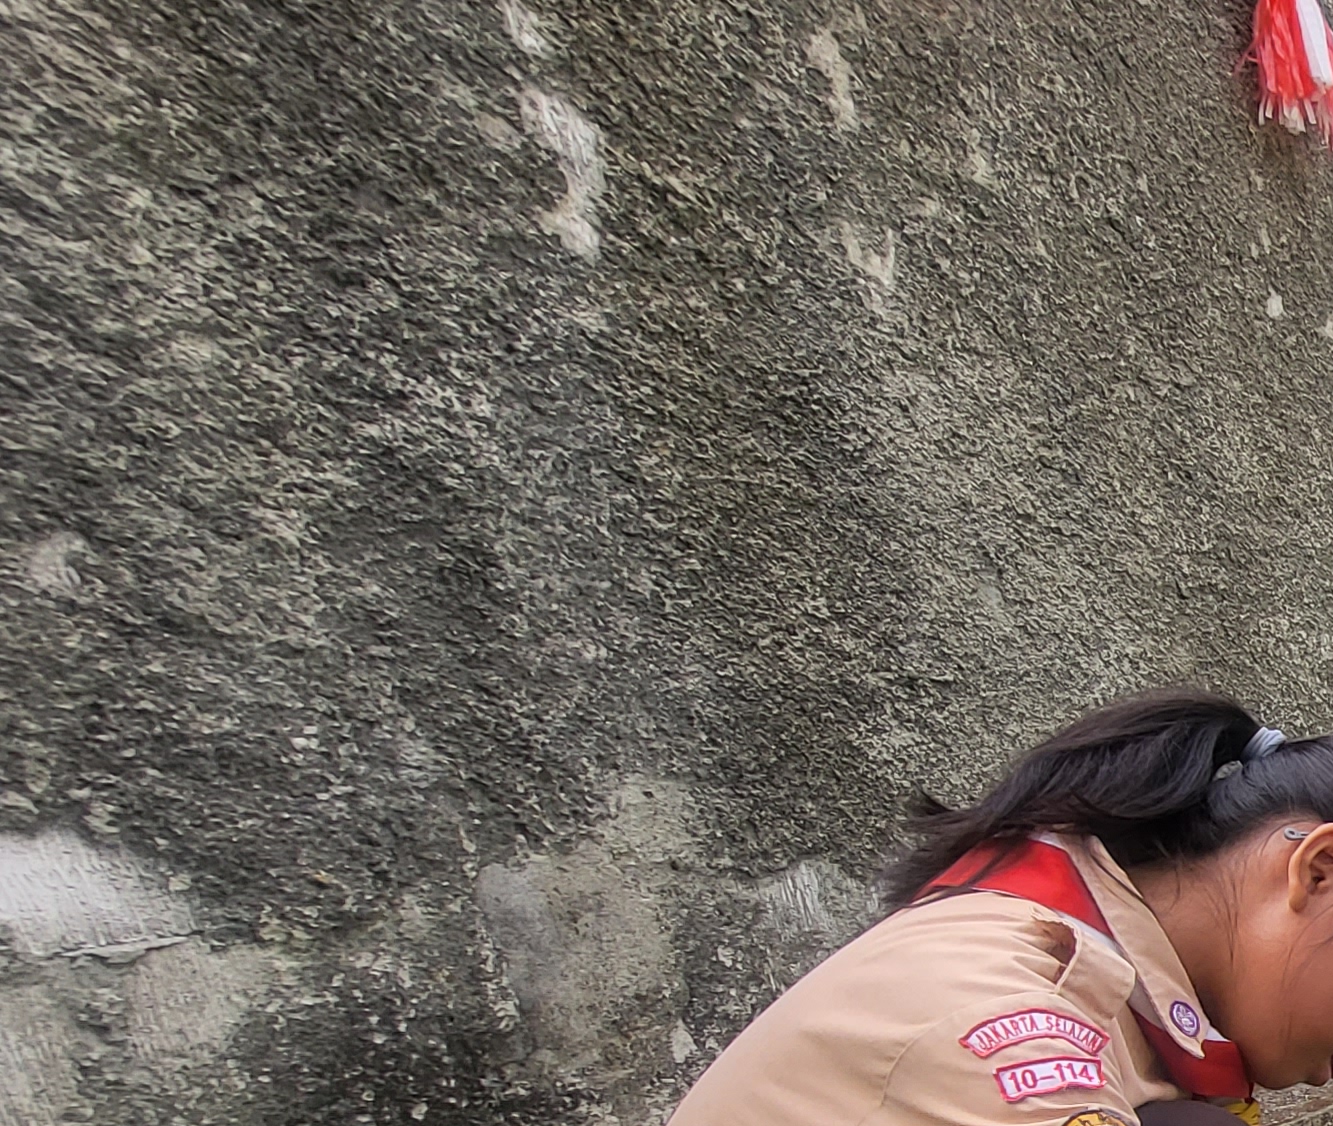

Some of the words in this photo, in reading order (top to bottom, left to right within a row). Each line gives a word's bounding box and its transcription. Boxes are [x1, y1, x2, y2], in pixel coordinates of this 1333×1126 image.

[975, 1014, 1038, 1050] JAKARTA
[1045, 1015, 1102, 1052] SELATAN
[1008, 1062, 1094, 1093] 10-114
